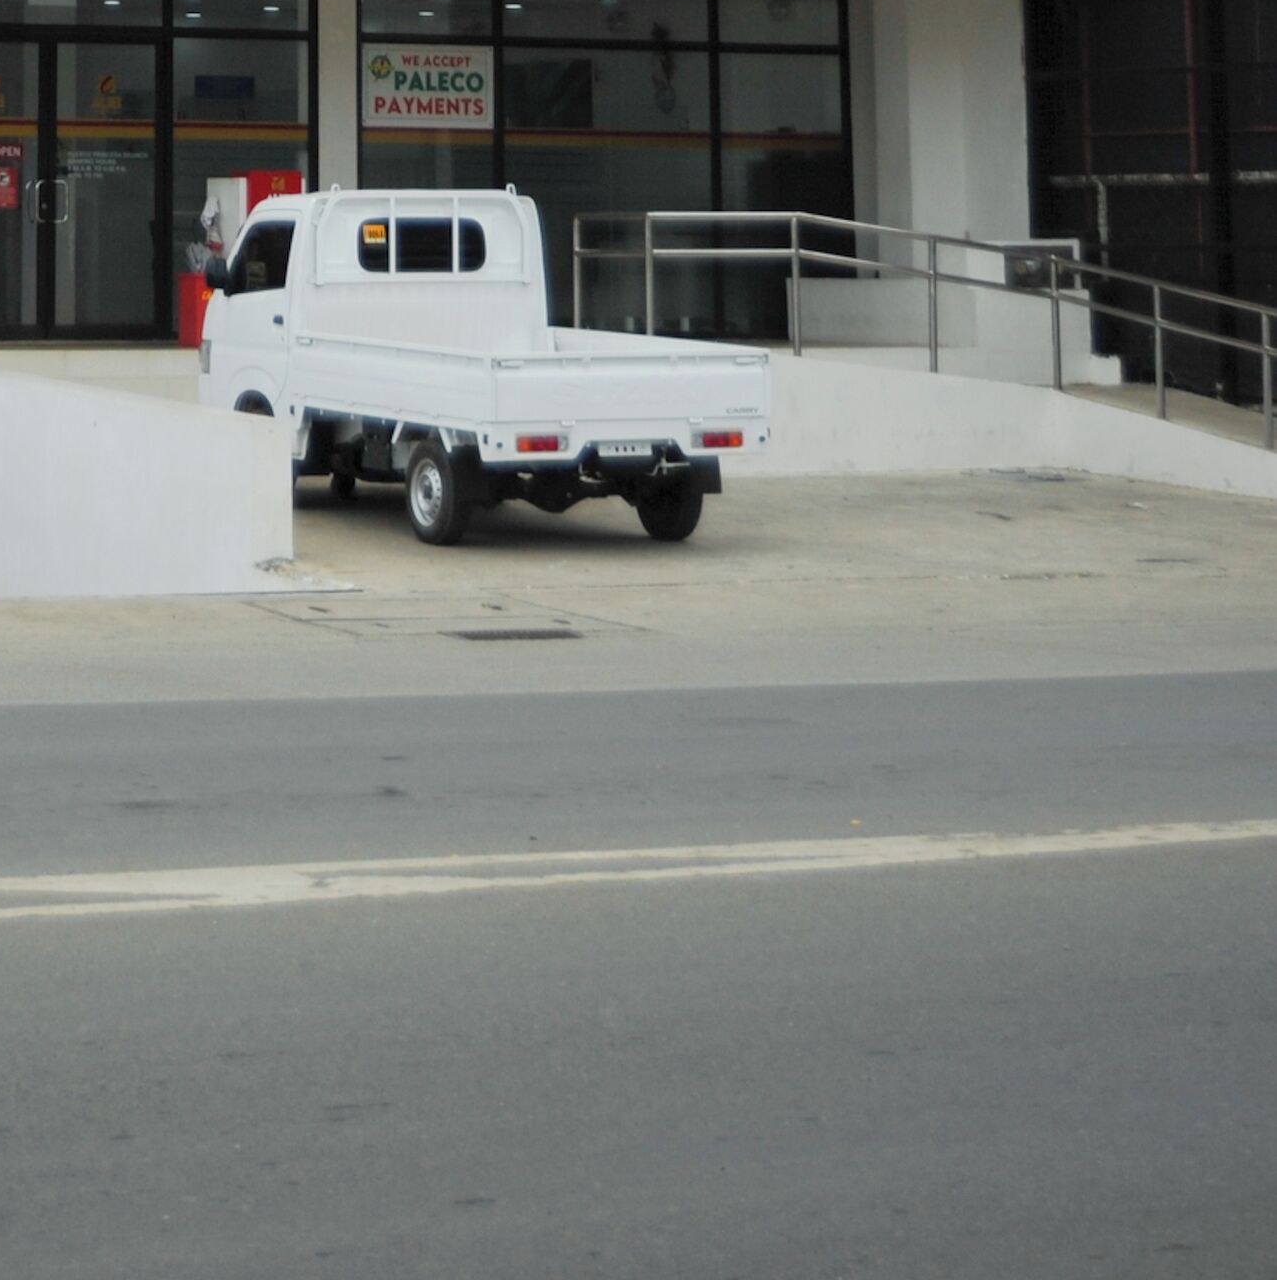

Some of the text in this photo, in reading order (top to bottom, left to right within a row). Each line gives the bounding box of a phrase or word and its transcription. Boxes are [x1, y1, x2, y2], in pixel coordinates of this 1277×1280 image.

[402, 55, 471, 68] WE ACCEPT
[394, 71, 484, 93] PALECO
[375, 96, 484, 116] PAYMENTS
